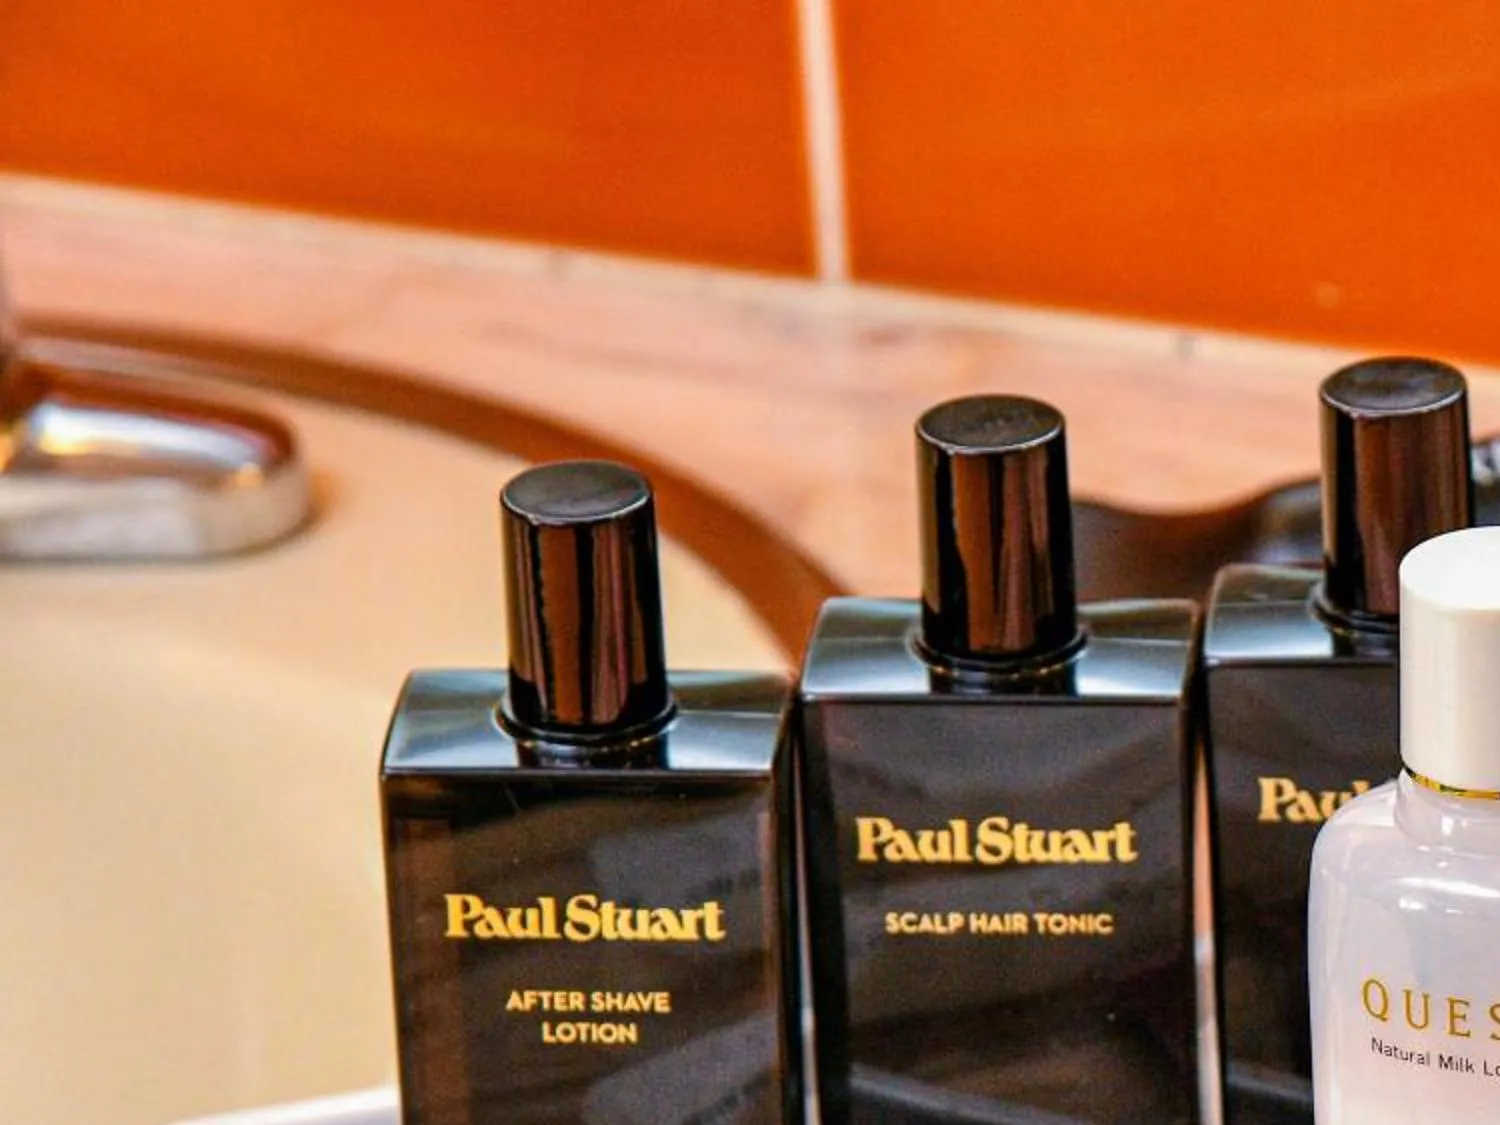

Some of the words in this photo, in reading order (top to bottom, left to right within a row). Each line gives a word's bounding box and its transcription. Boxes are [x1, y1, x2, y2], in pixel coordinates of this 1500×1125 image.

[855, 816, 973, 863] Paul
[974, 816, 1138, 864] Stuart
[444, 893, 562, 940] Paul
[563, 893, 727, 942] Stuart
[885, 911, 965, 934] SCALP
[969, 912, 1028, 934] HAIR
[1033, 912, 1114, 935] TONIC
[506, 990, 585, 1012] AFTER
[592, 991, 672, 1014] SHAVE
[542, 1021, 638, 1044] LOTION
[1371, 1036, 1431, 1066] Natural
[1438, 1053, 1475, 1074] Milk
